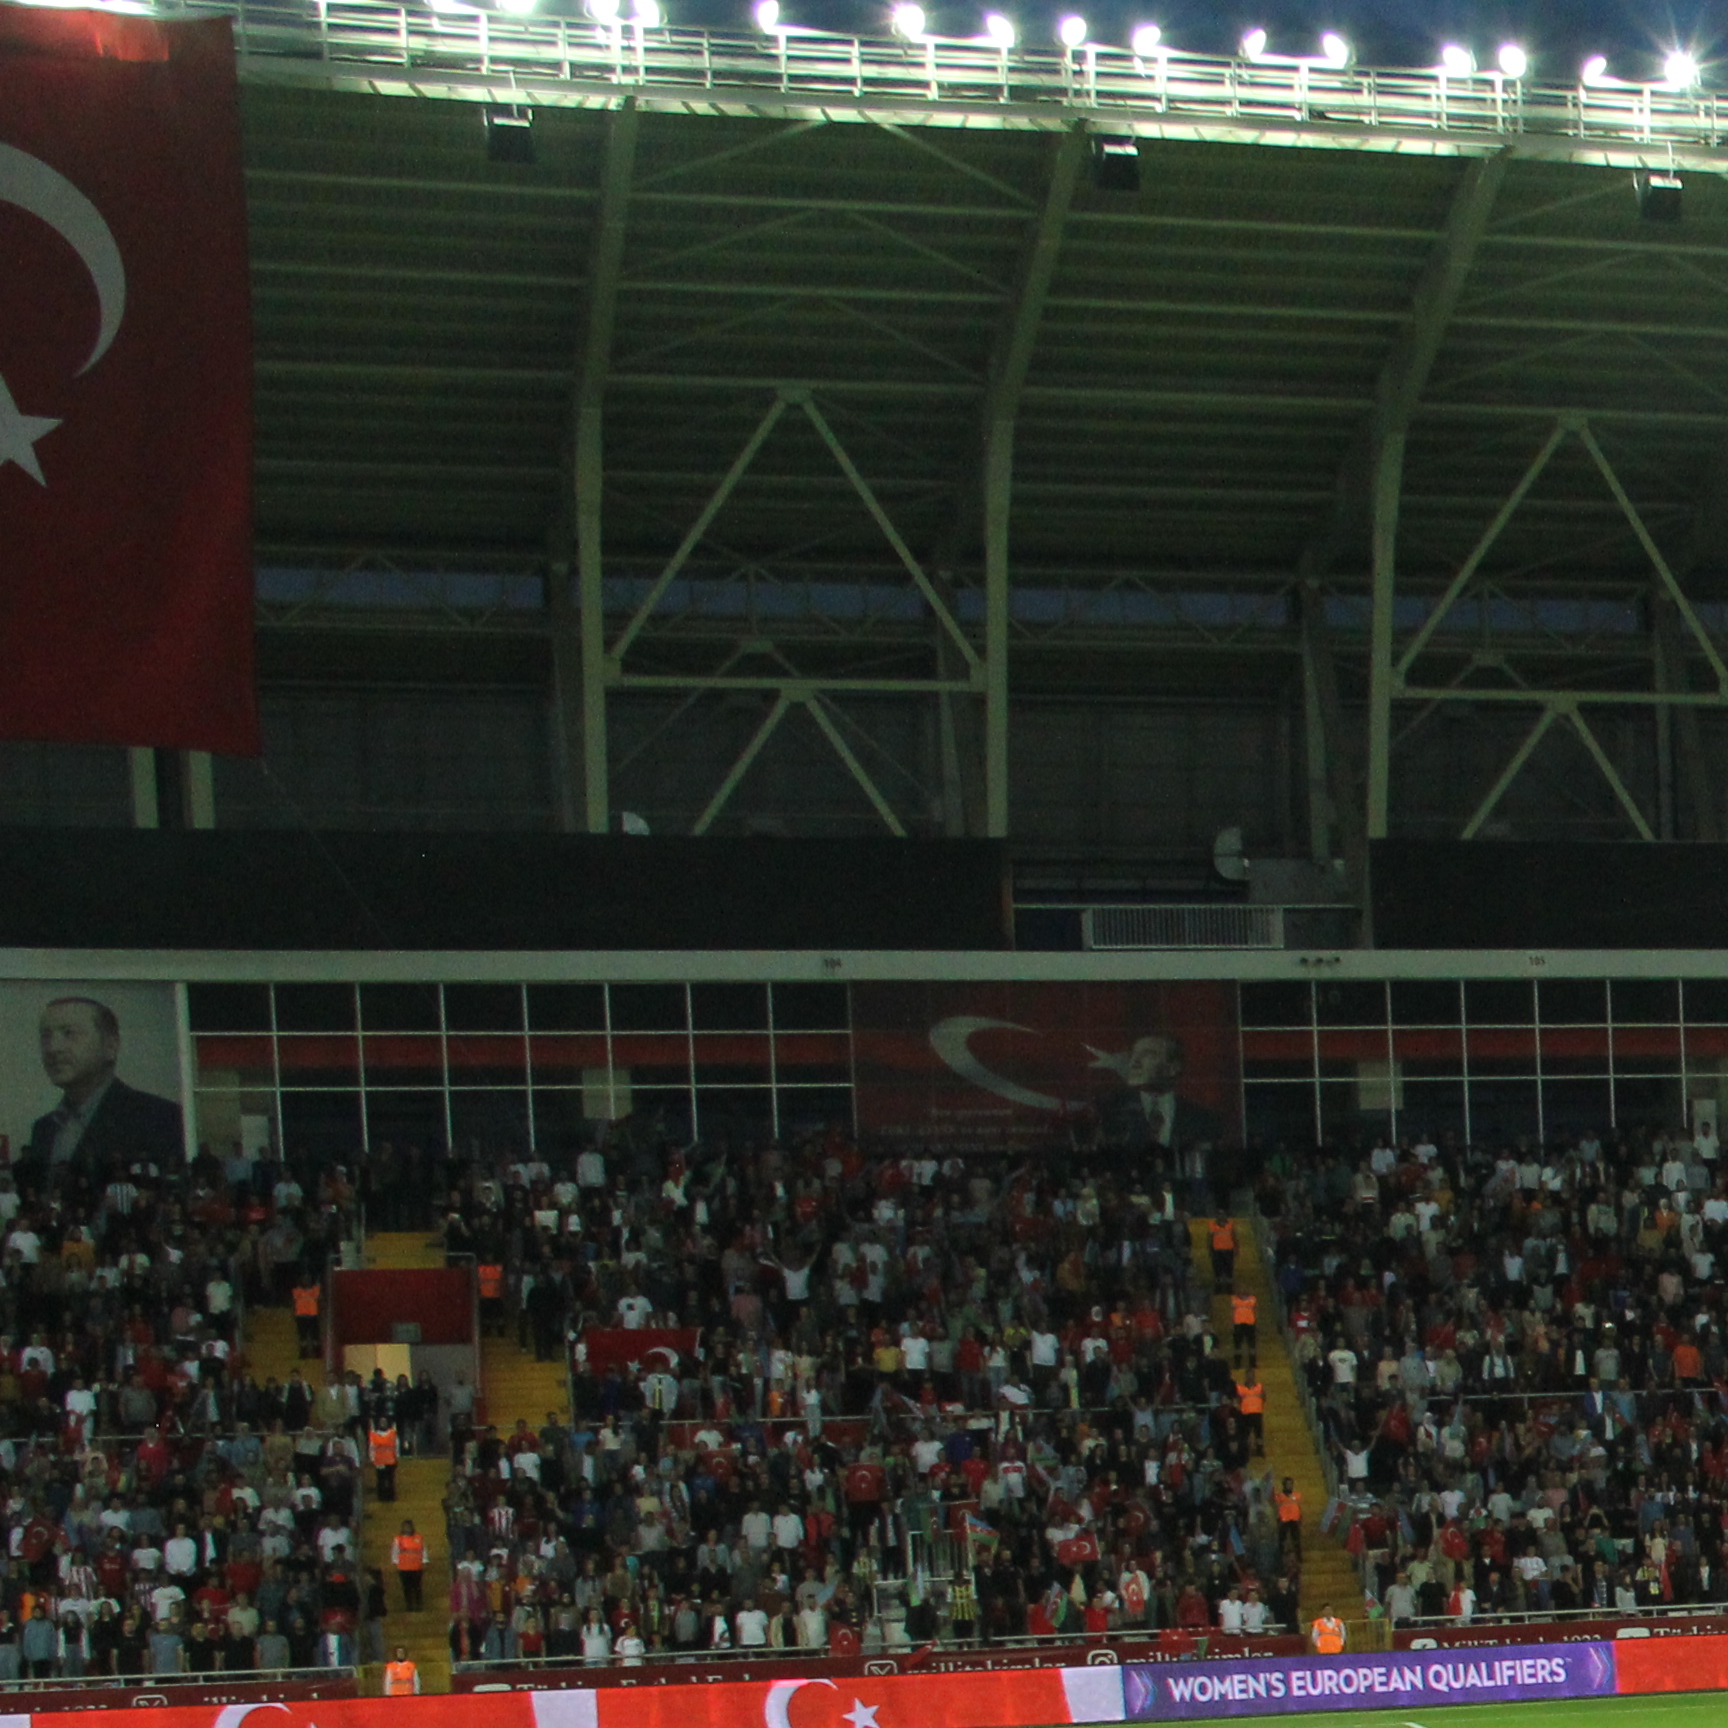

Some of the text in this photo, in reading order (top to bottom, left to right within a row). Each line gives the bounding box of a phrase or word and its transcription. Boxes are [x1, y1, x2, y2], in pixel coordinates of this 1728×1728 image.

[1167, 1659, 1566, 1703] WOMEN'S EUROPEAN QUALIFIERS
